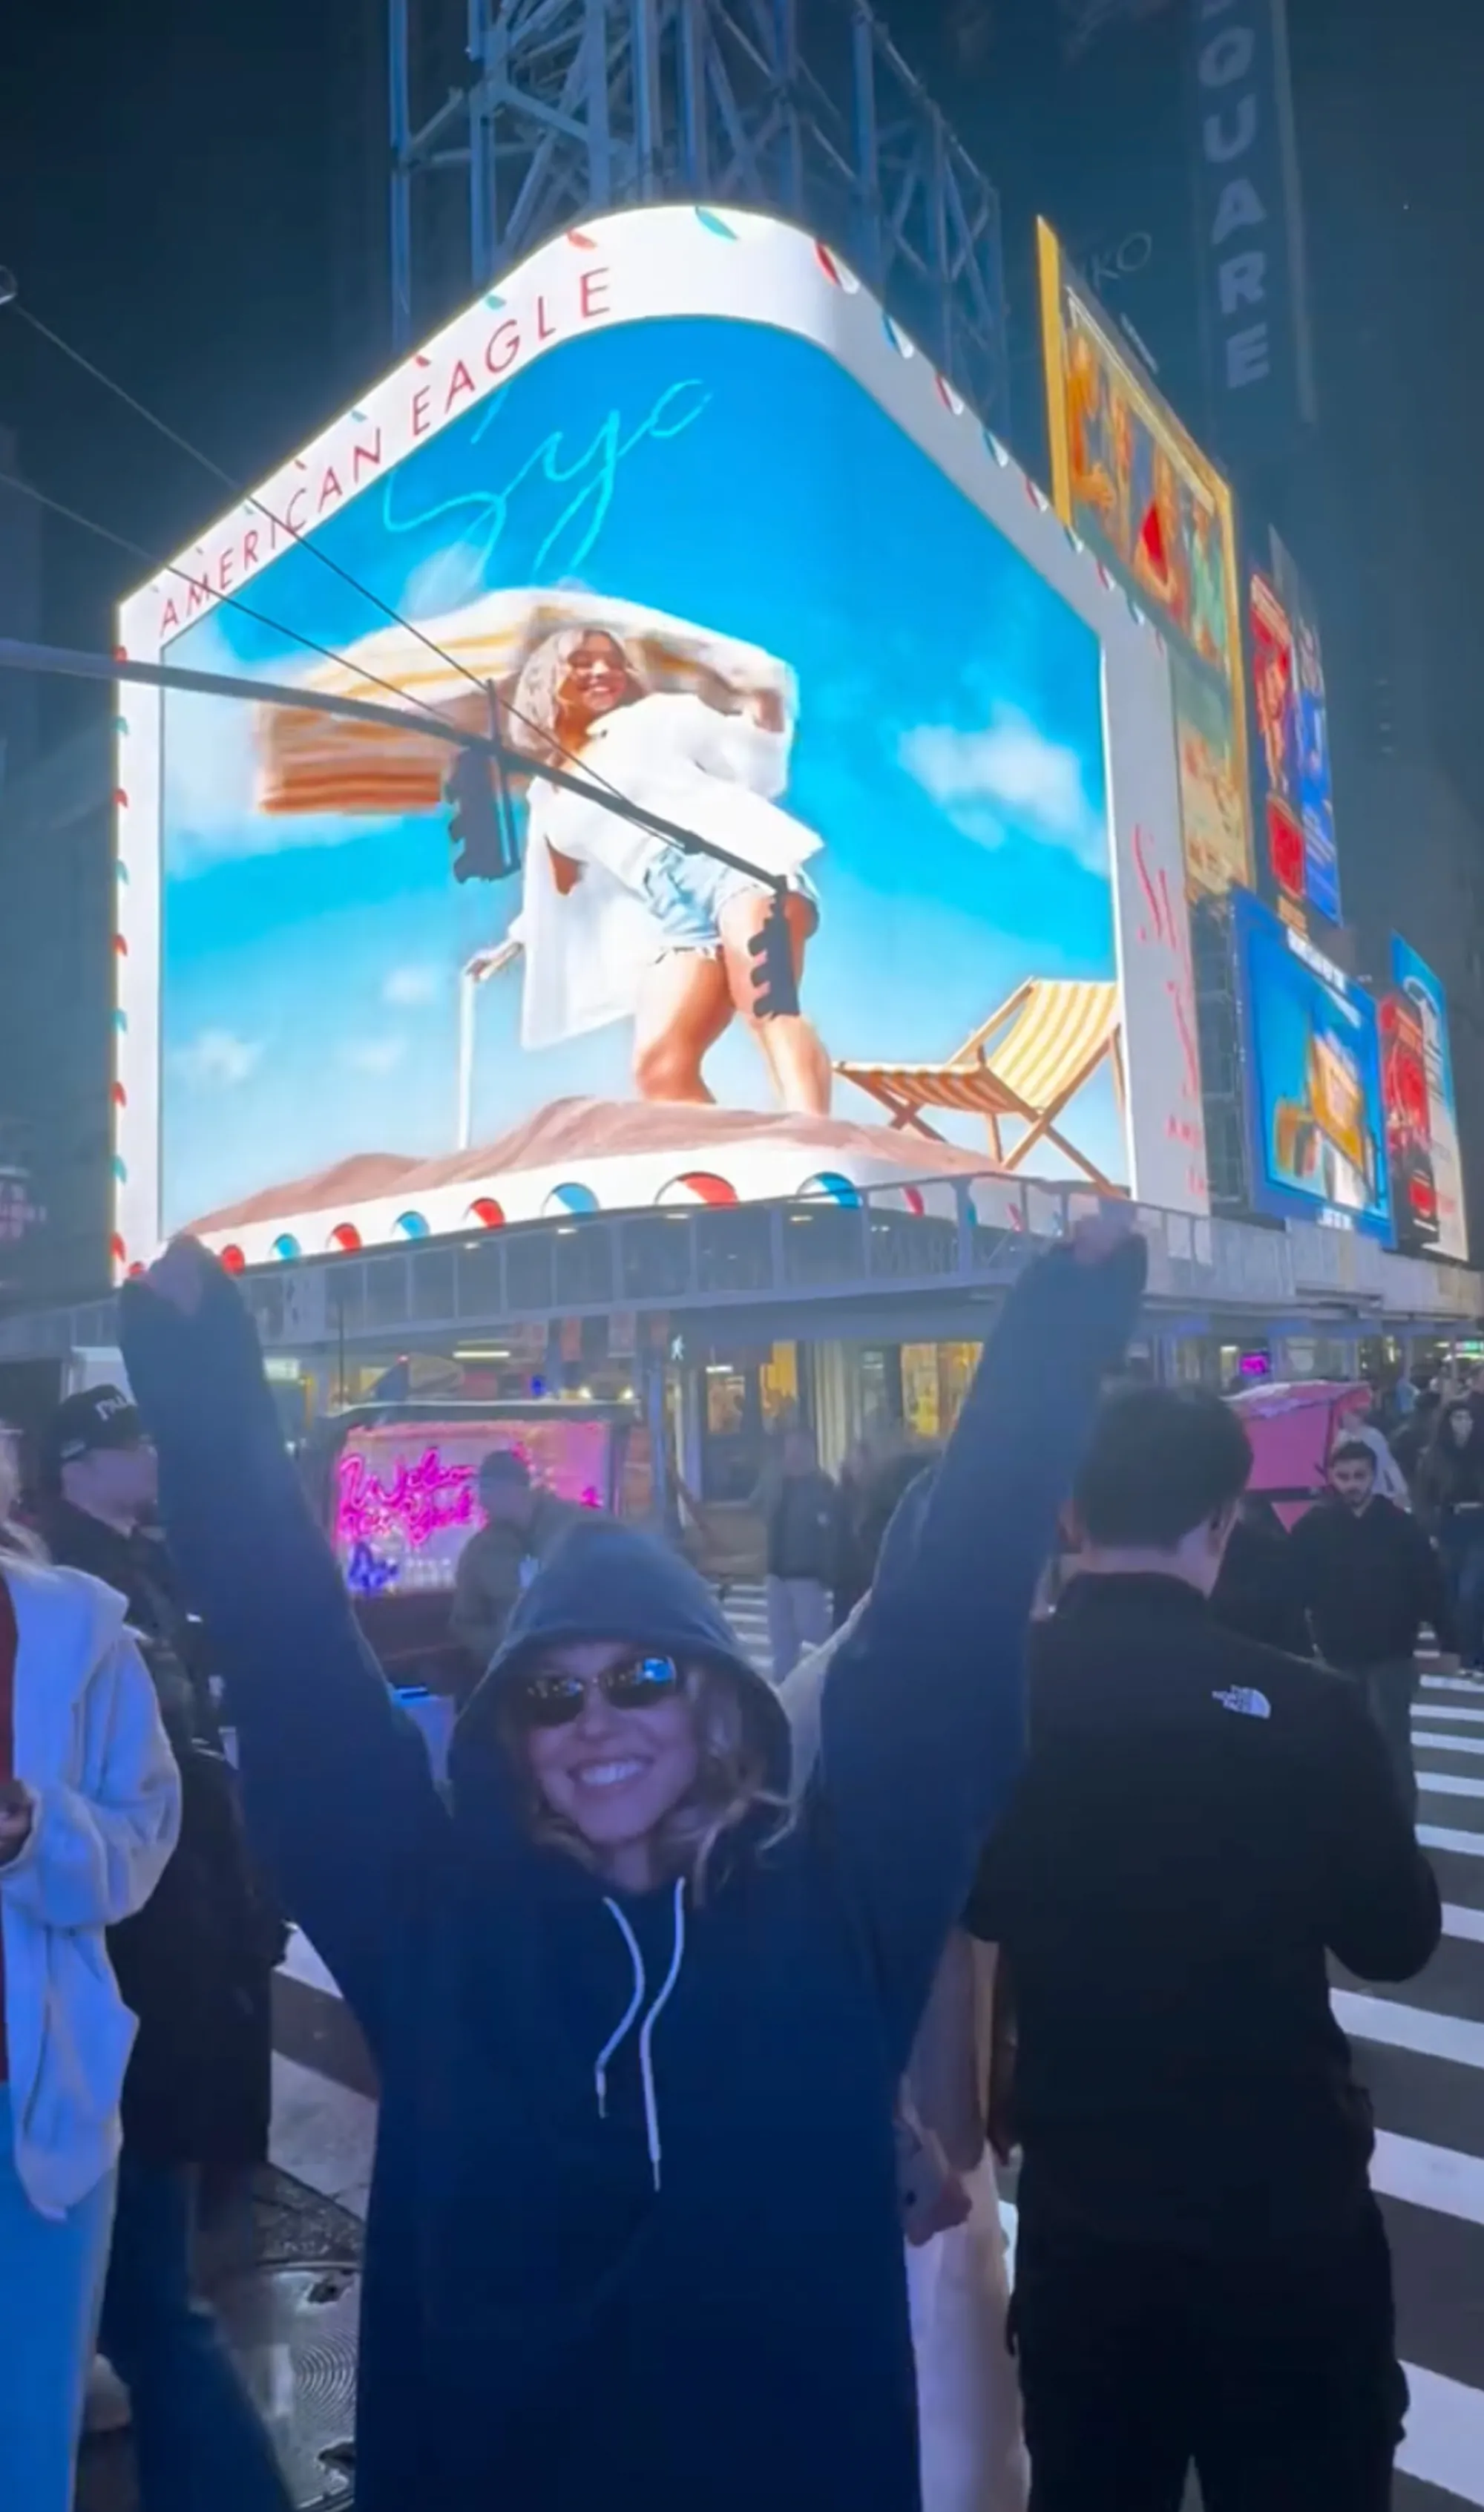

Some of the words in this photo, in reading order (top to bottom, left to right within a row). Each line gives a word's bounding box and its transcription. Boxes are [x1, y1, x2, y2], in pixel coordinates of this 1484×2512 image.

[1198, 0, 1270, 390] QUARE
[159, 426, 381, 639] AMERICAN
[412, 266, 611, 438] EAGLE
